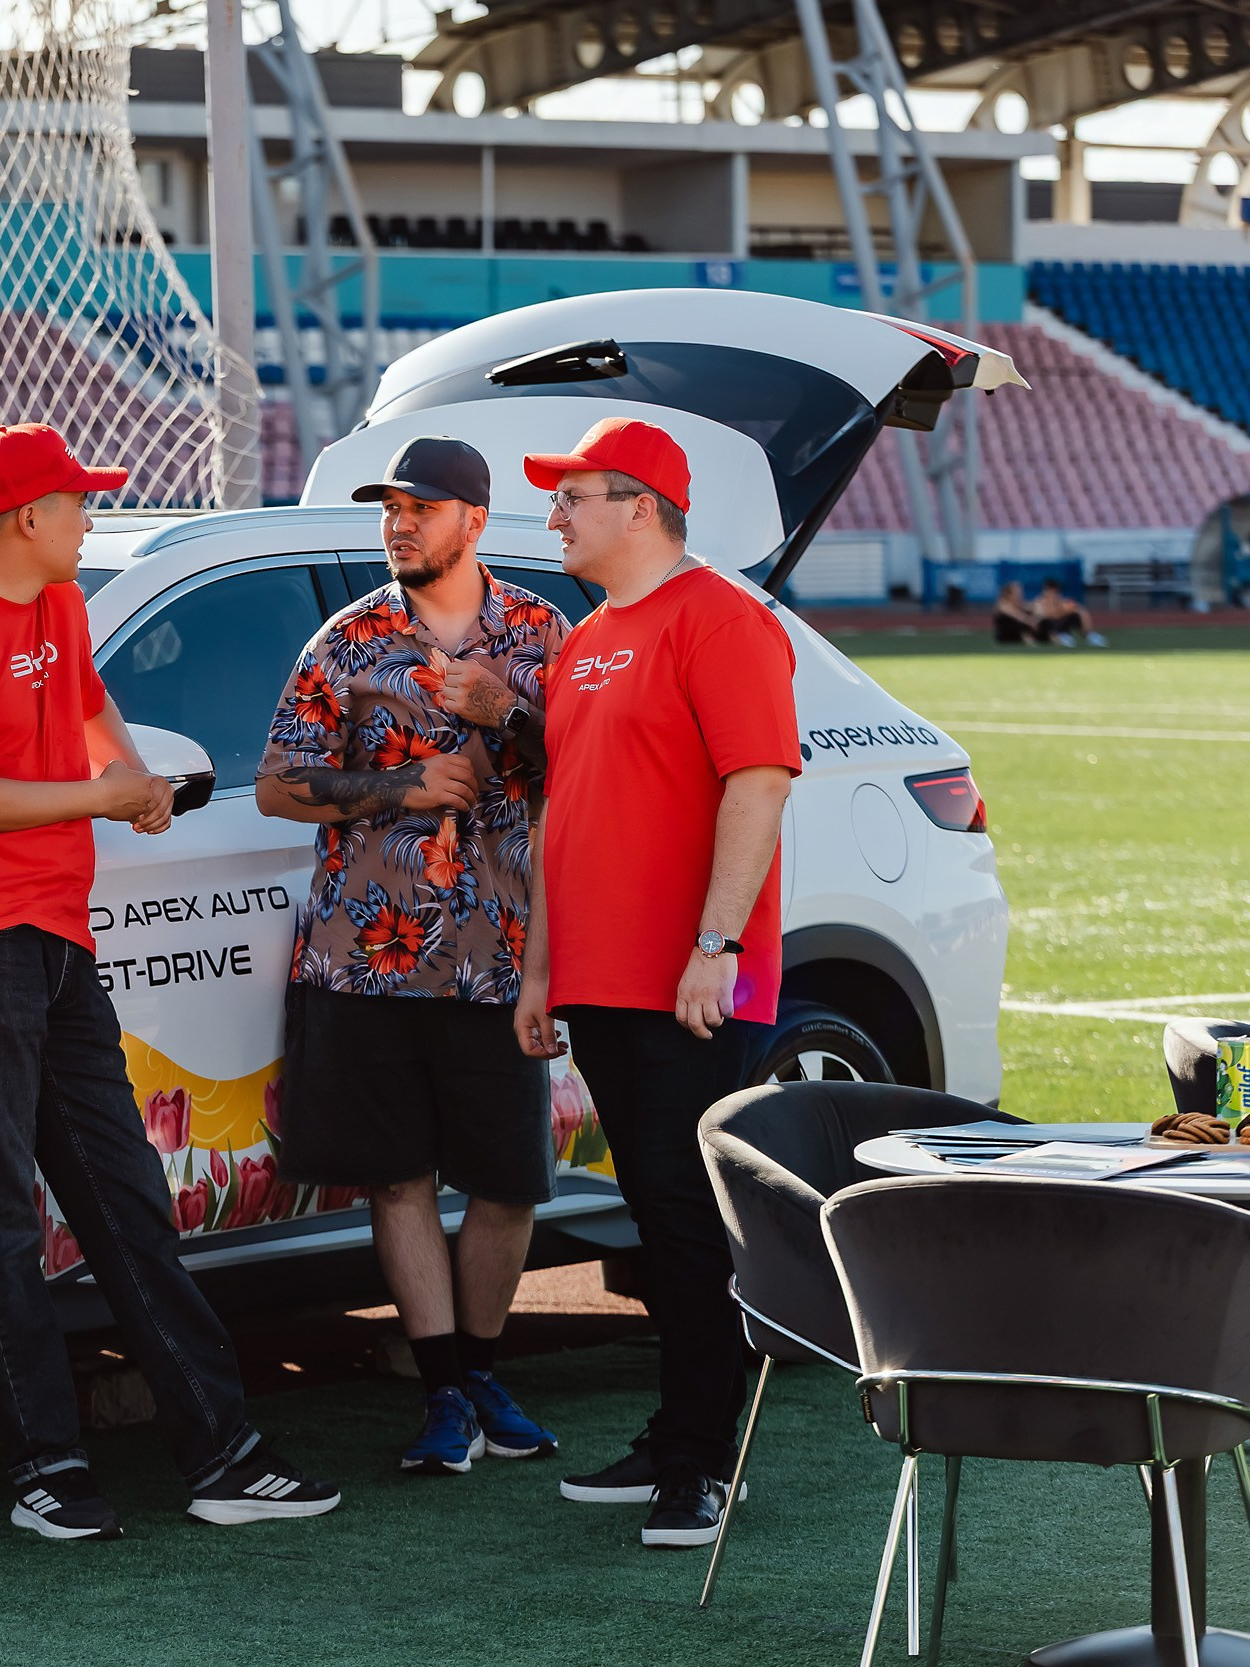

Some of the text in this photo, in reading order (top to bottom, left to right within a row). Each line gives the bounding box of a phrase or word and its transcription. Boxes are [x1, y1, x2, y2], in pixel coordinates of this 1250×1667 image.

[11, 640, 58, 678] BYD
[571, 650, 634, 680] BYD
[809, 720, 938, 757] apex auto
[124, 896, 204, 928] APEX
[212, 886, 290, 918] AUTO
